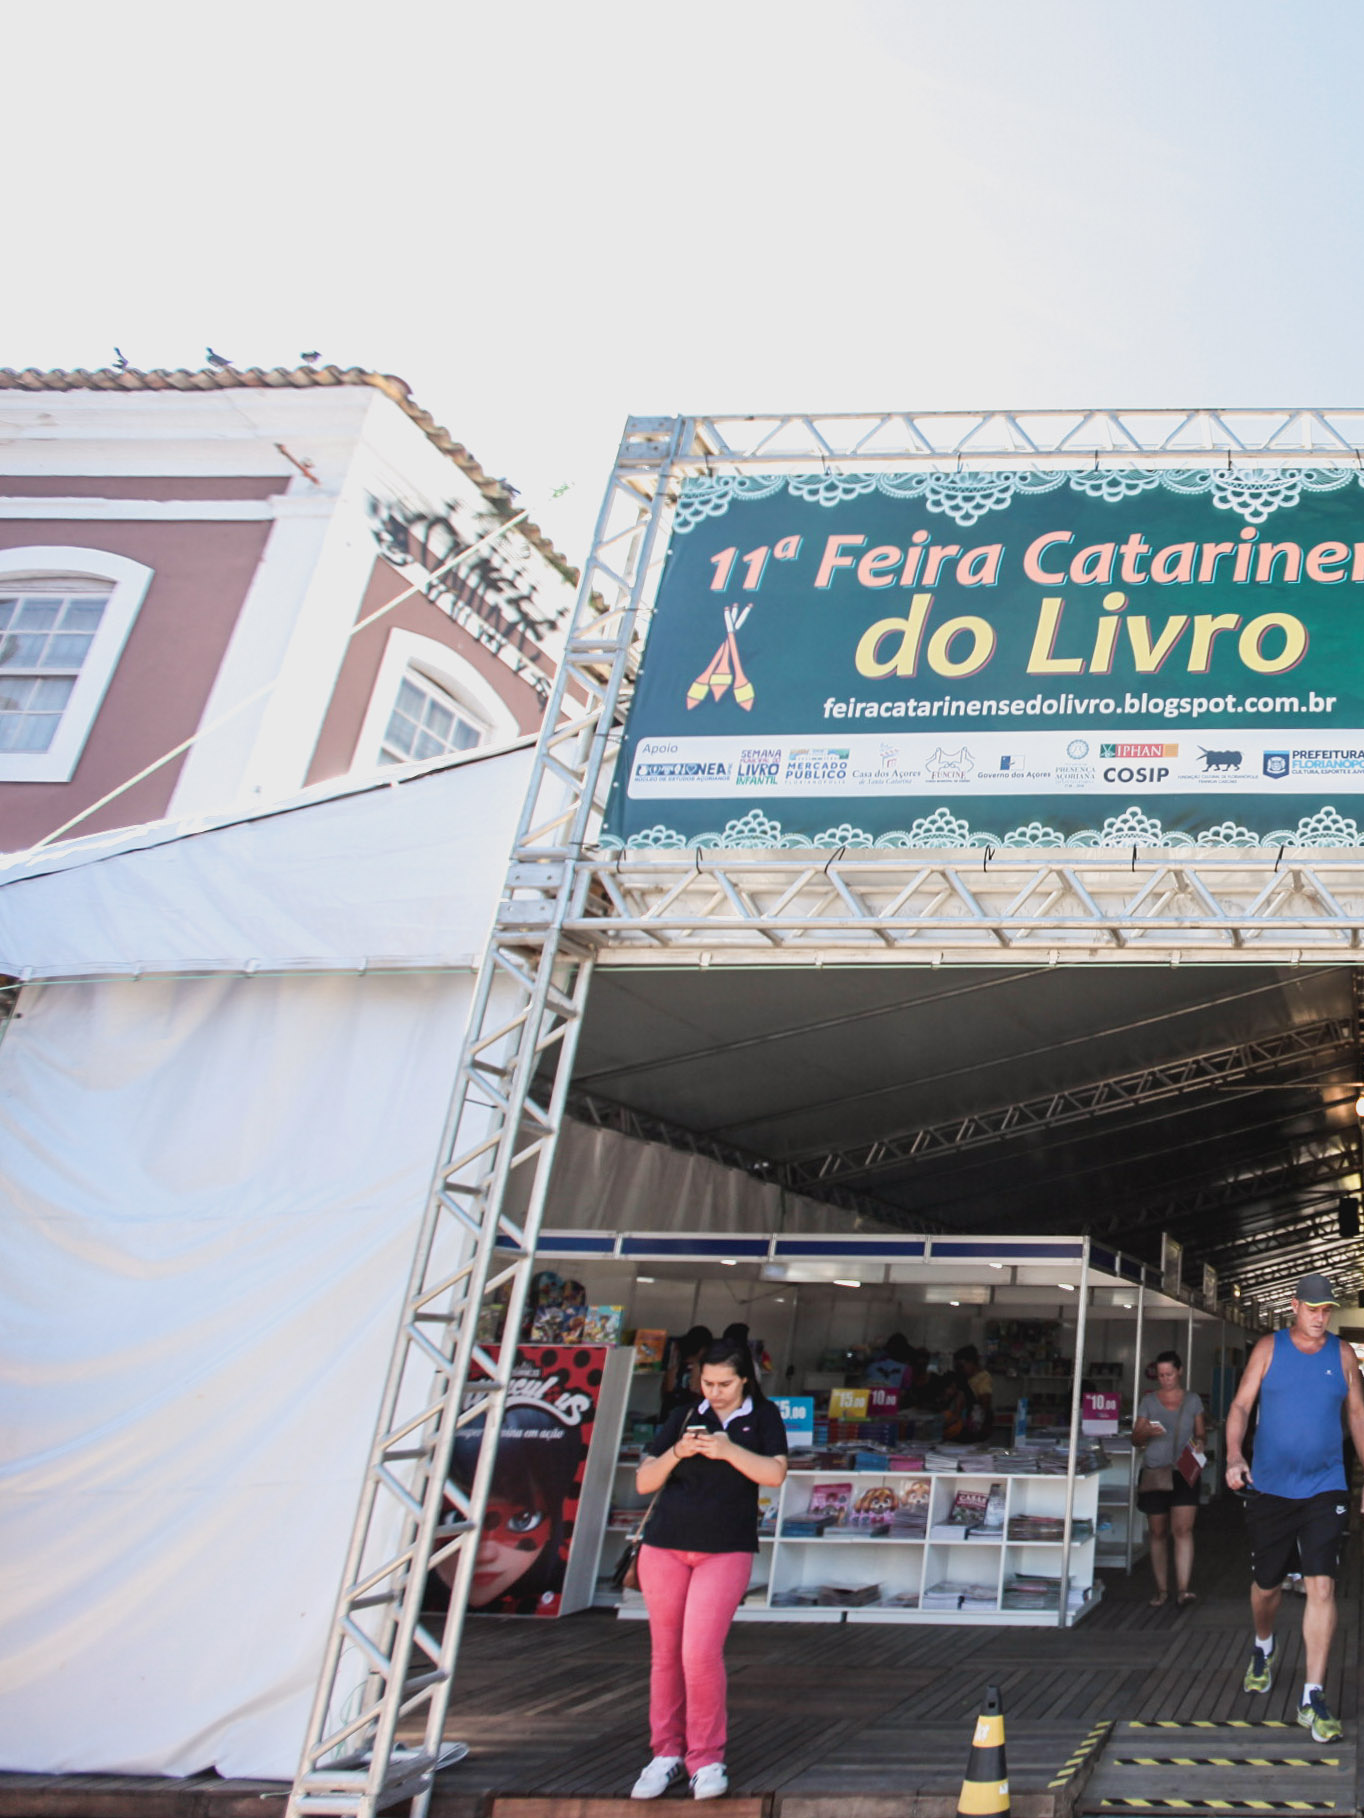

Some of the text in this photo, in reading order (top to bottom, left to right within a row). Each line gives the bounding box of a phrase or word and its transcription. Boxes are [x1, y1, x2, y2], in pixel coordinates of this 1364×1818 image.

[814, 529, 1005, 589] Feira
[855, 591, 1310, 680] do Livro
[823, 692, 1337, 719] feiracatarinensedolivro.blogspot.com.br
[642, 742, 679, 755] Apoio
[740, 749, 782, 759] SEMANA
[1117, 744, 1162, 757] IPHAN
[737, 763, 780, 777] LIVRO
[787, 761, 848, 770] MERCADO
[736, 775, 778, 785] INFANTIL
[852, 769, 921, 780] Casa dos Açores
[977, 771, 1051, 781] Governo dos Açores
[1103, 767, 1170, 784] COSIP
